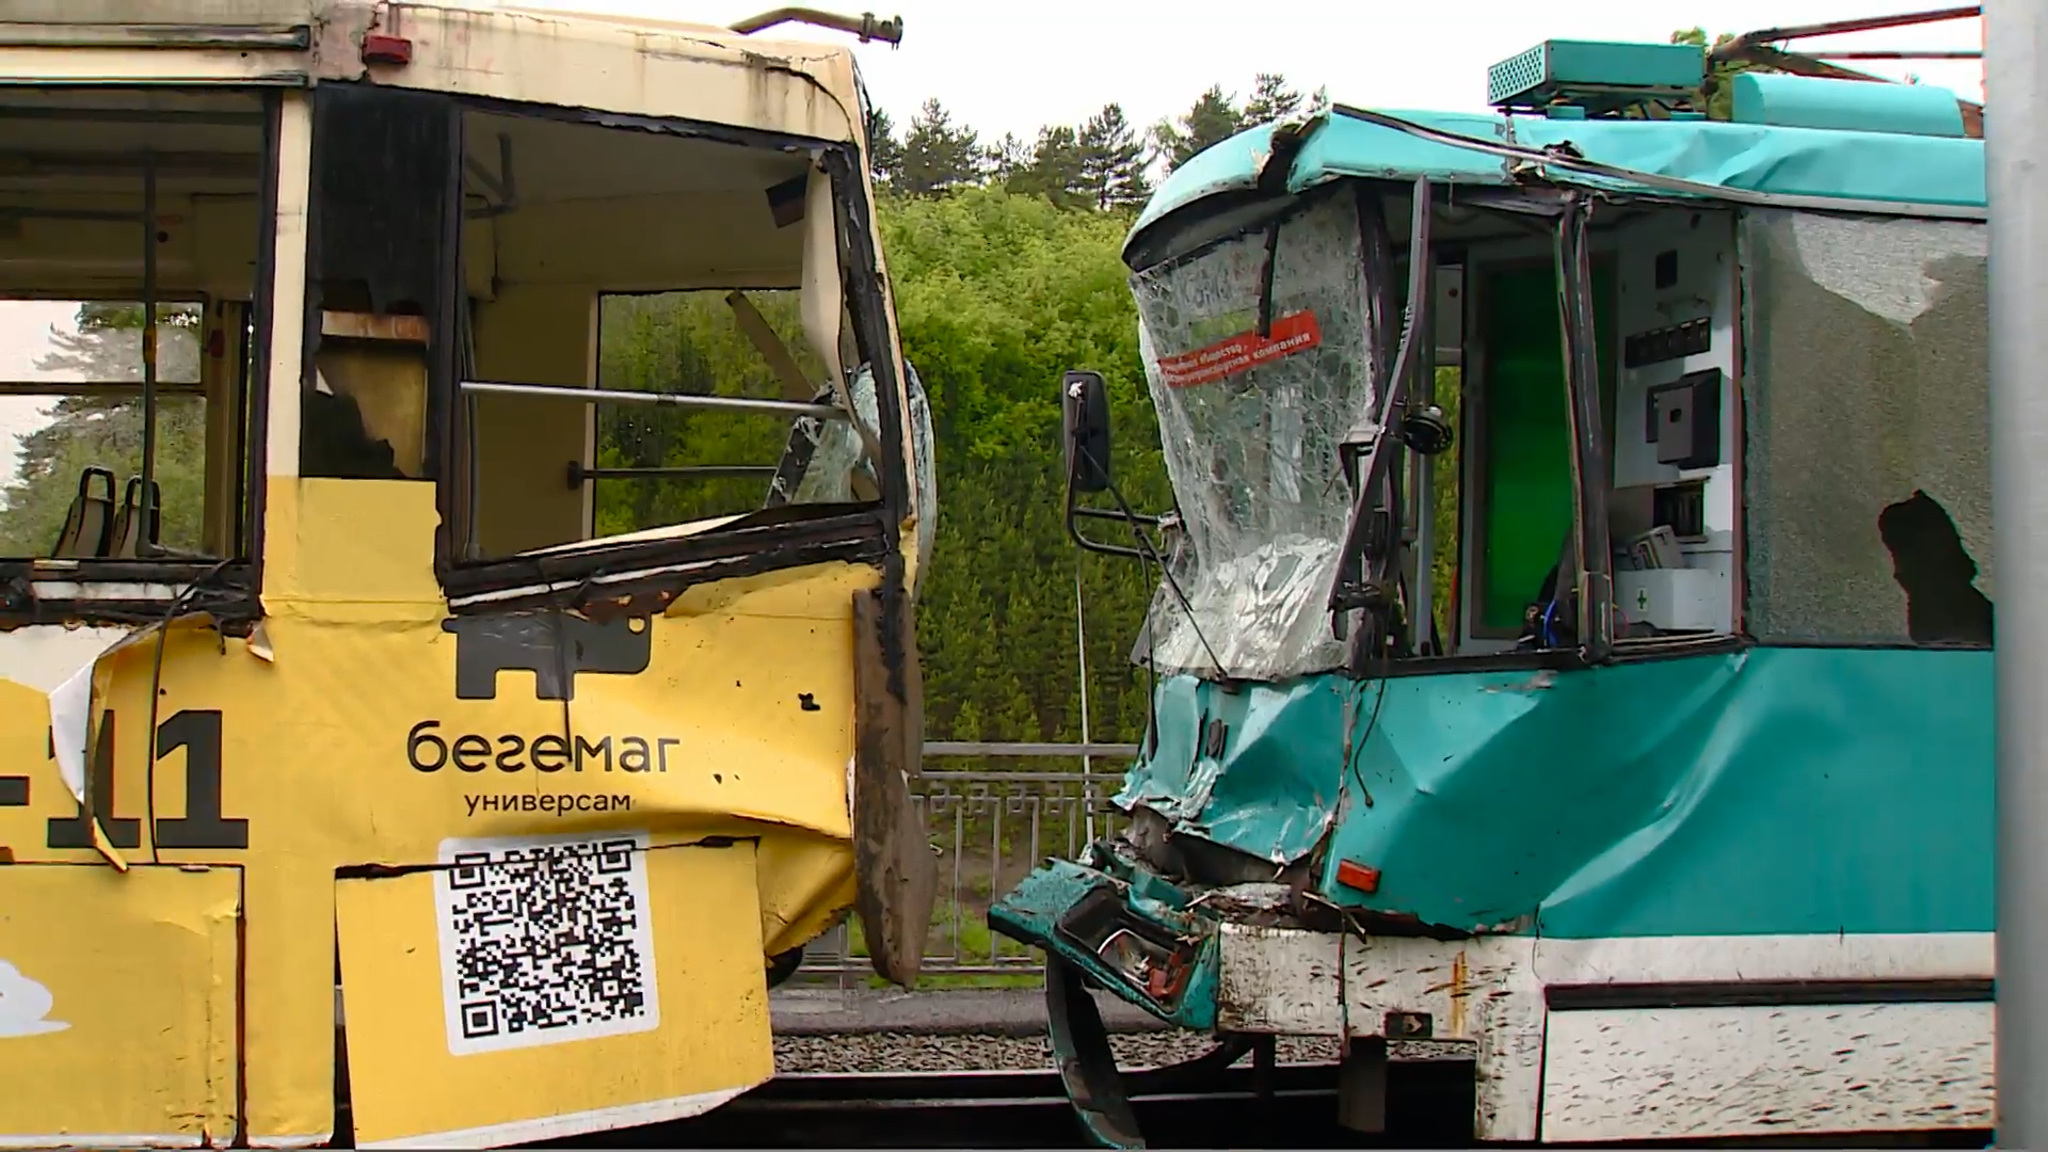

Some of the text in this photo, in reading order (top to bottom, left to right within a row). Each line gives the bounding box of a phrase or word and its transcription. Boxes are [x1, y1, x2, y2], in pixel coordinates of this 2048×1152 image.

[1252, 332, 1311, 360] компания
[407, 720, 681, 773] бегемаг
[464, 793, 631, 816] универсам
